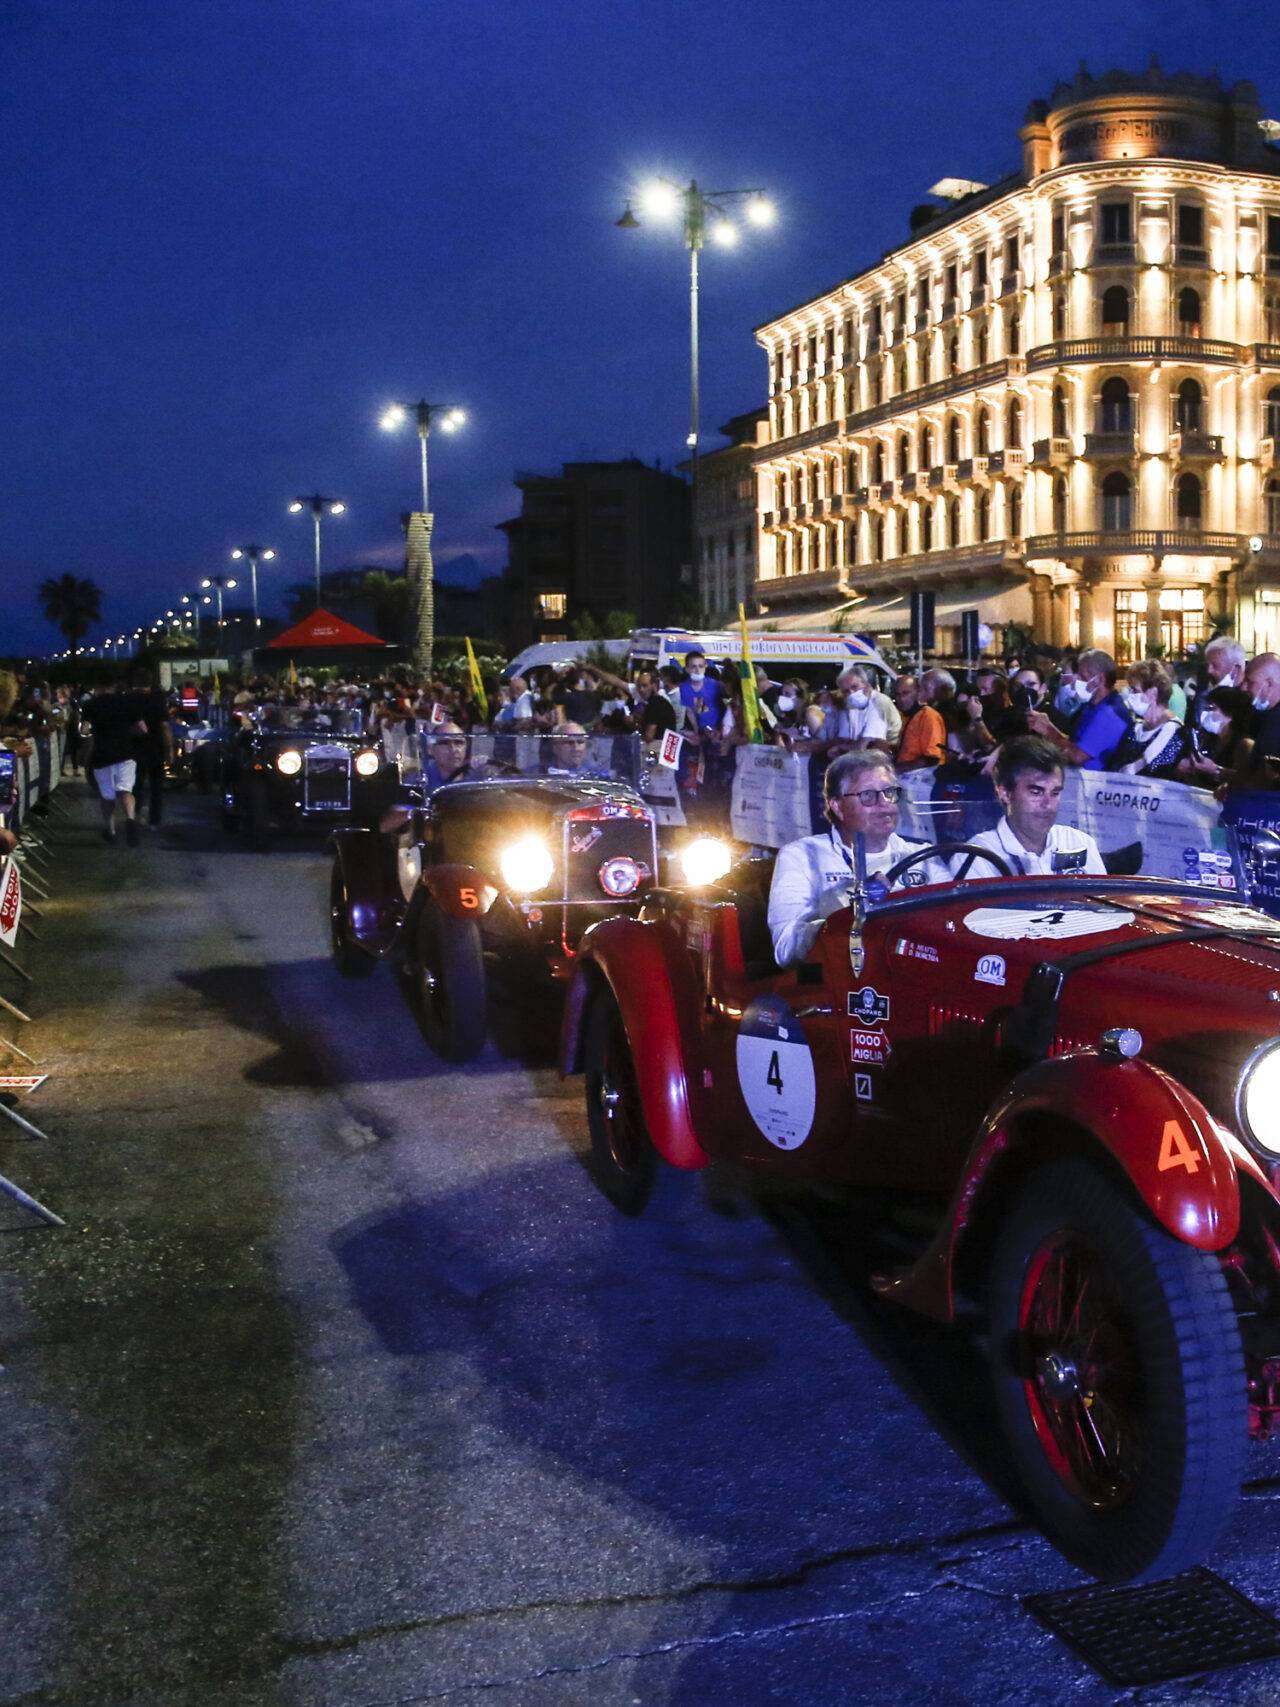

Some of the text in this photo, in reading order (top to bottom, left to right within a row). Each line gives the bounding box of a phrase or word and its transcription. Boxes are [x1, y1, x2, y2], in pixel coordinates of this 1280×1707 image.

[1095, 790, 1161, 812] CHOPARD
[460, 888, 479, 909] 5
[981, 959, 1001, 976] OM
[854, 1034, 881, 1047] 1000
[853, 1048, 884, 1062] MIGLIA
[766, 1051, 784, 1096] 4
[1157, 1119, 1201, 1175] 4
